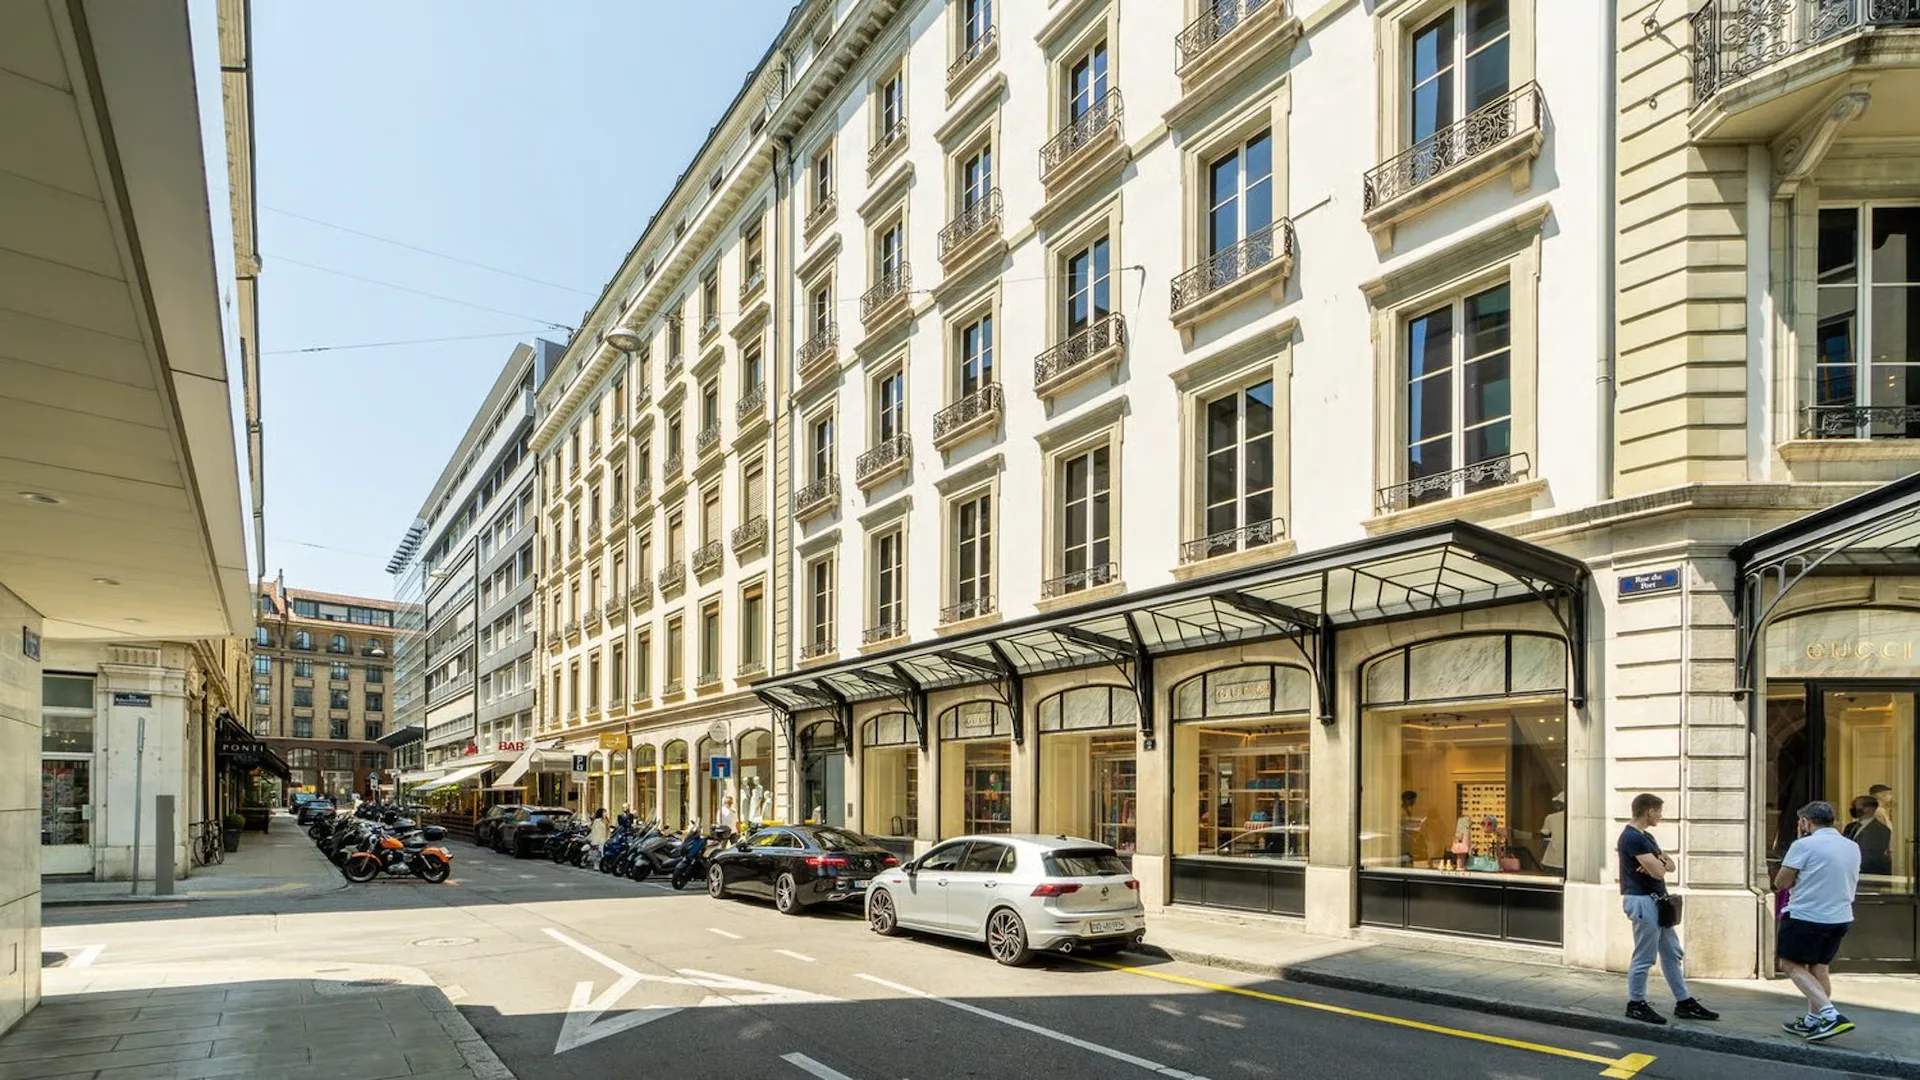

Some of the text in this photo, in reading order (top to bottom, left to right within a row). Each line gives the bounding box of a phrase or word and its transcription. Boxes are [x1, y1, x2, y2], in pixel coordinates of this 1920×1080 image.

[1651, 573, 1662, 581] du
[1640, 582, 1656, 590] Port
[1806, 641, 1912, 661] GUCCI
[222, 743, 264, 752] PONTI
[498, 741, 525, 752] BAR
